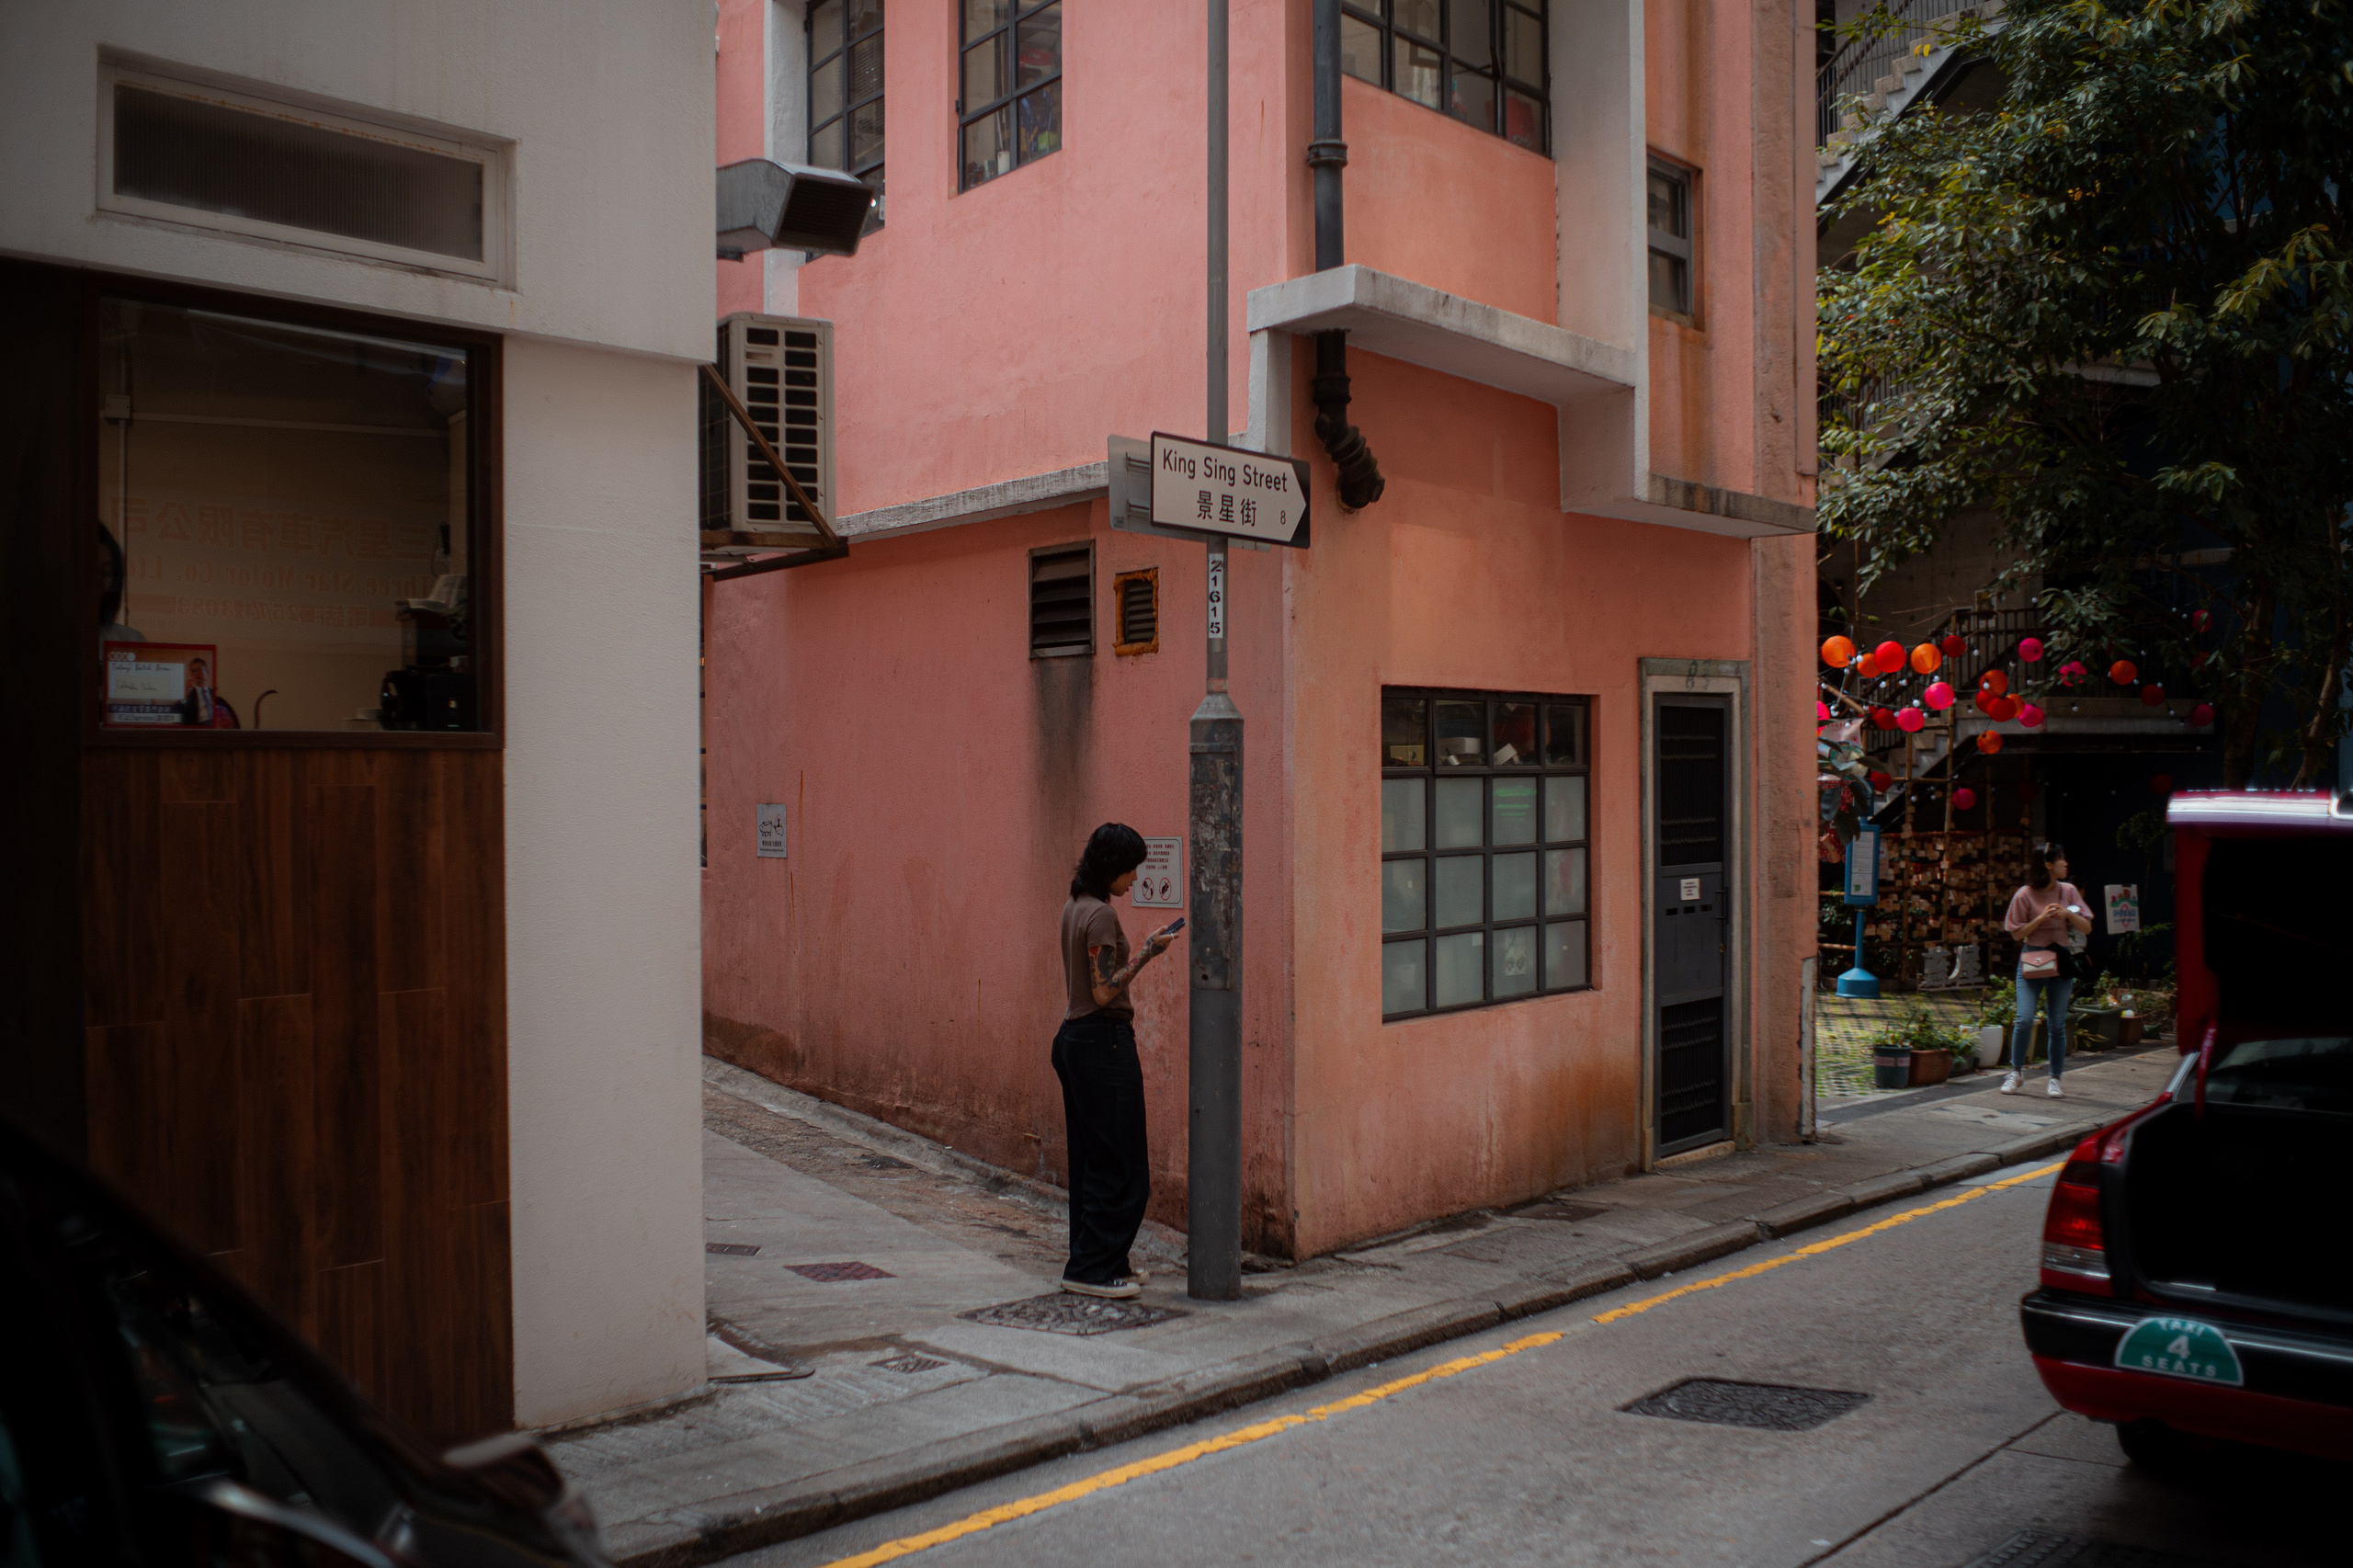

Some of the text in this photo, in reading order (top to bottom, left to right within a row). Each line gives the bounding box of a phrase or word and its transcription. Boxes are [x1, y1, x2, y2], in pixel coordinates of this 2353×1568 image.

[1163, 448, 1288, 492] King Sing Street
[1197, 490, 1256, 527] 景星街
[1279, 510, 1287, 526] 8
[1209, 560, 1222, 634] 21615
[2157, 1319, 2206, 1337] TAXI
[2166, 1335, 2191, 1359] 4
[2142, 1355, 2217, 1378] SEATS
